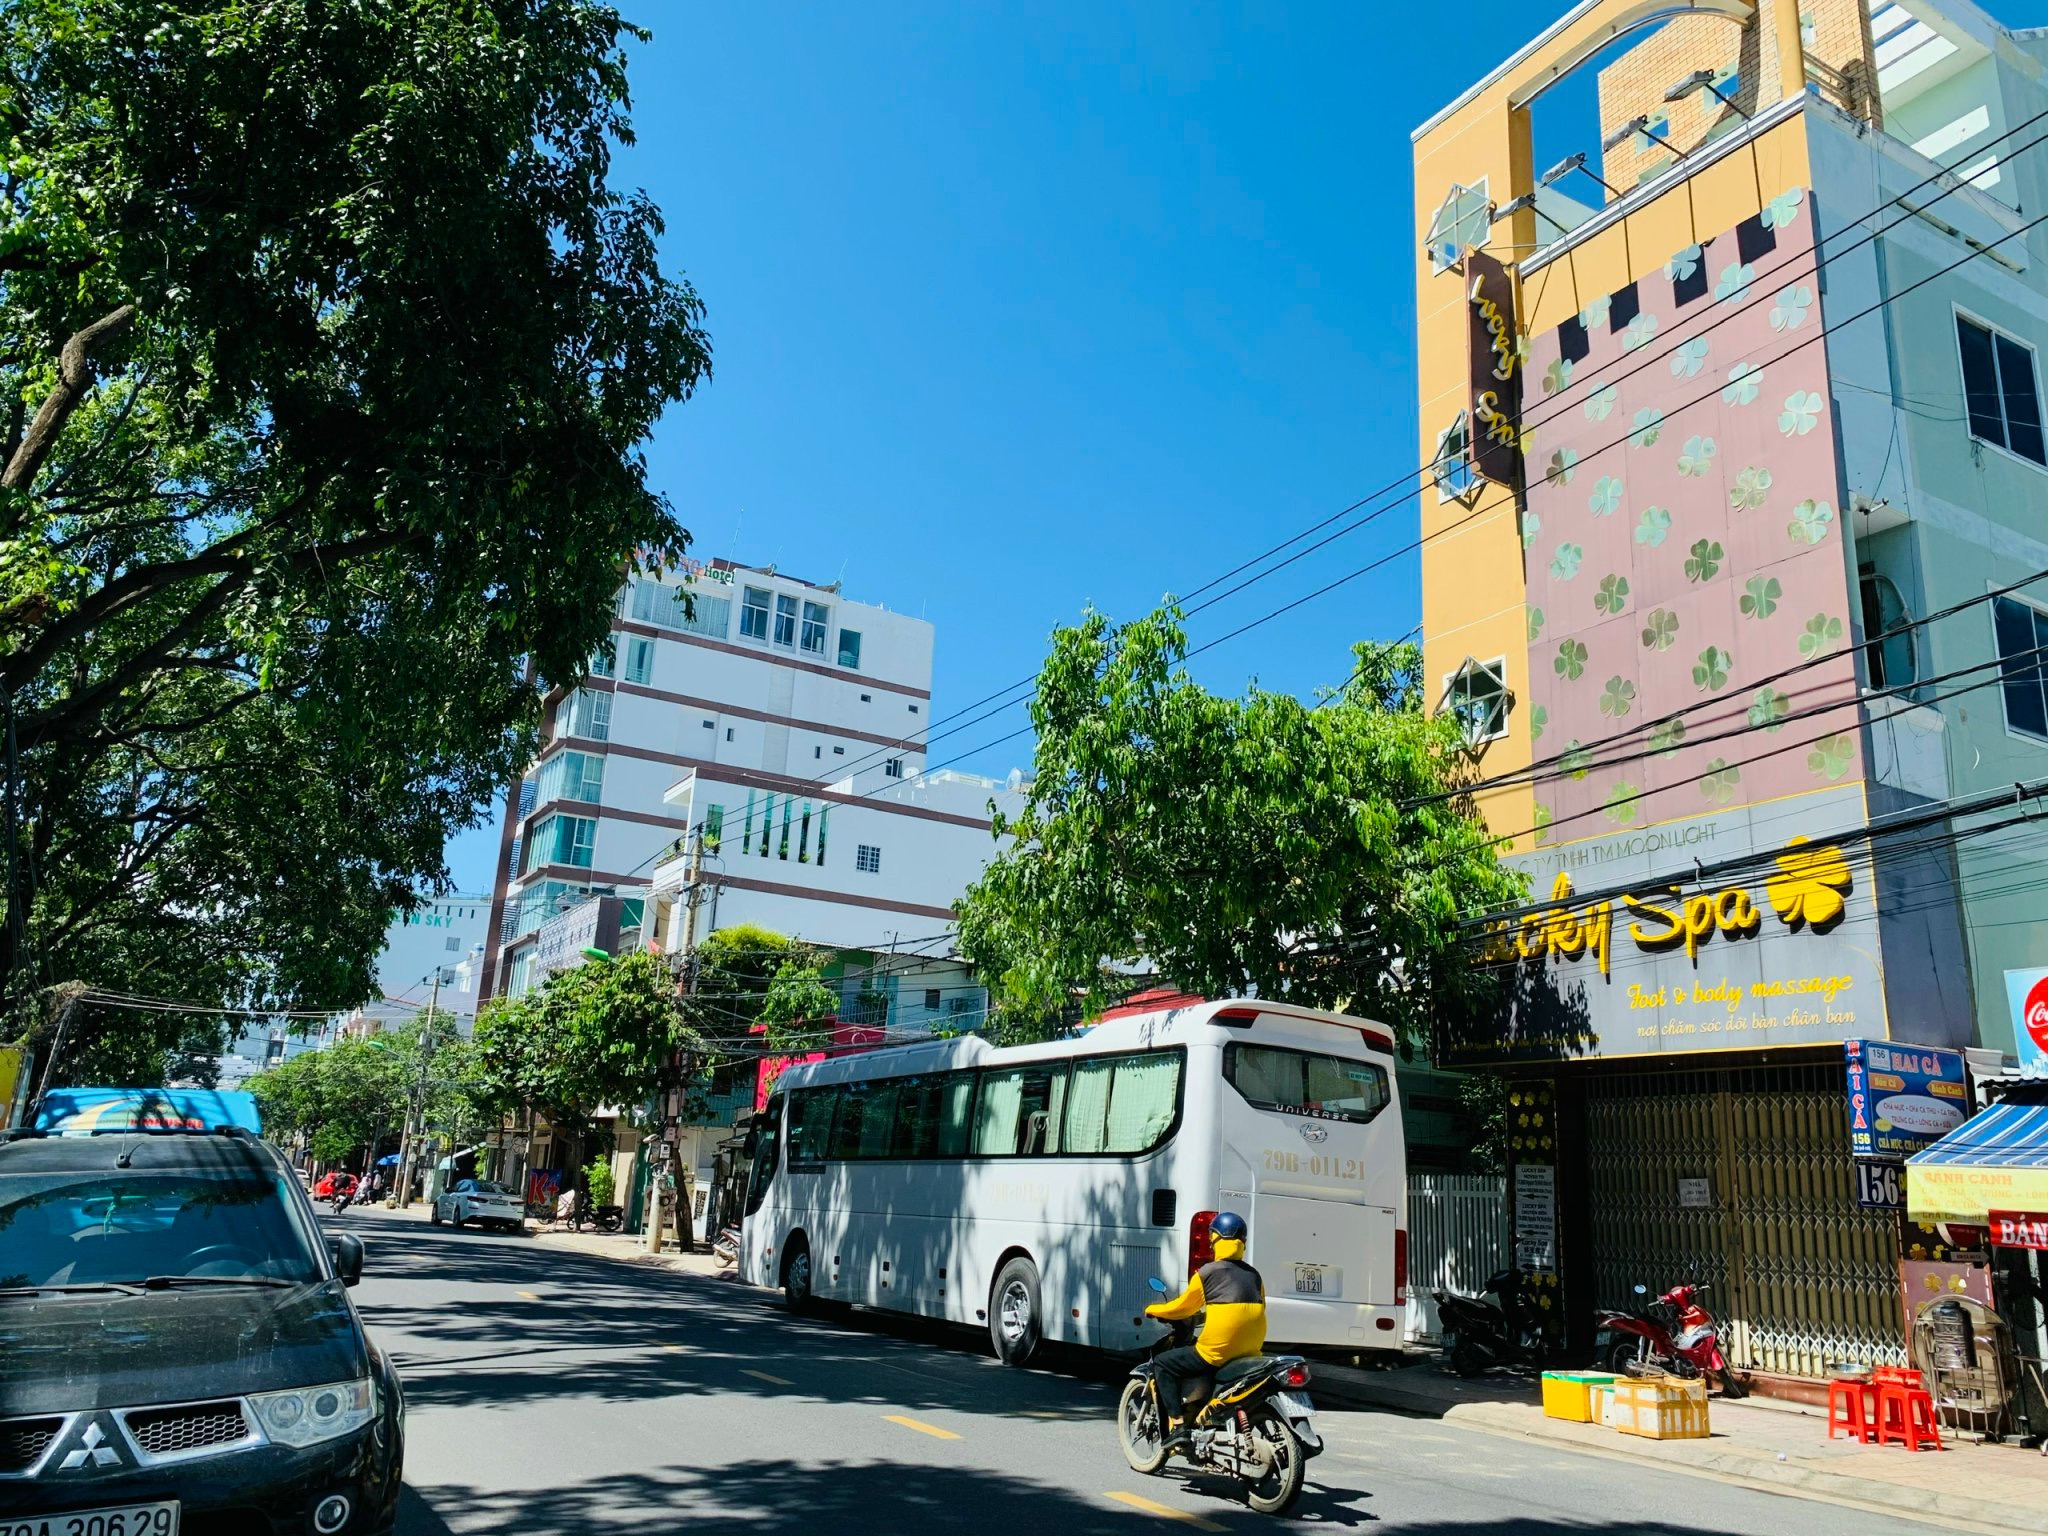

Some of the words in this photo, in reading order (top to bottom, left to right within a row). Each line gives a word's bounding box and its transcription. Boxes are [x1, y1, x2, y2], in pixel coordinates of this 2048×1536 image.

[1471, 273, 1515, 380] Lucky
[1475, 391, 1518, 447] Spa
[704, 565, 735, 584] Hotel
[1592, 844, 1613, 861] TM
[425, 914, 454, 928] SKY
[1622, 886, 1762, 959] Spa
[1627, 983, 1667, 1009] Foot
[1692, 977, 1743, 1012] body
[1750, 974, 1854, 1003] massage
[1872, 1049, 1887, 1059] 156
[1891, 1052, 1920, 1074] HAI
[1921, 1053, 1943, 1077] CÁ
[1275, 1103, 1350, 1121] UNIVERSE
[1852, 1133, 1871, 1145] 156
[528, 1170, 560, 1205] K+
[1859, 1164, 1899, 1205] 156
